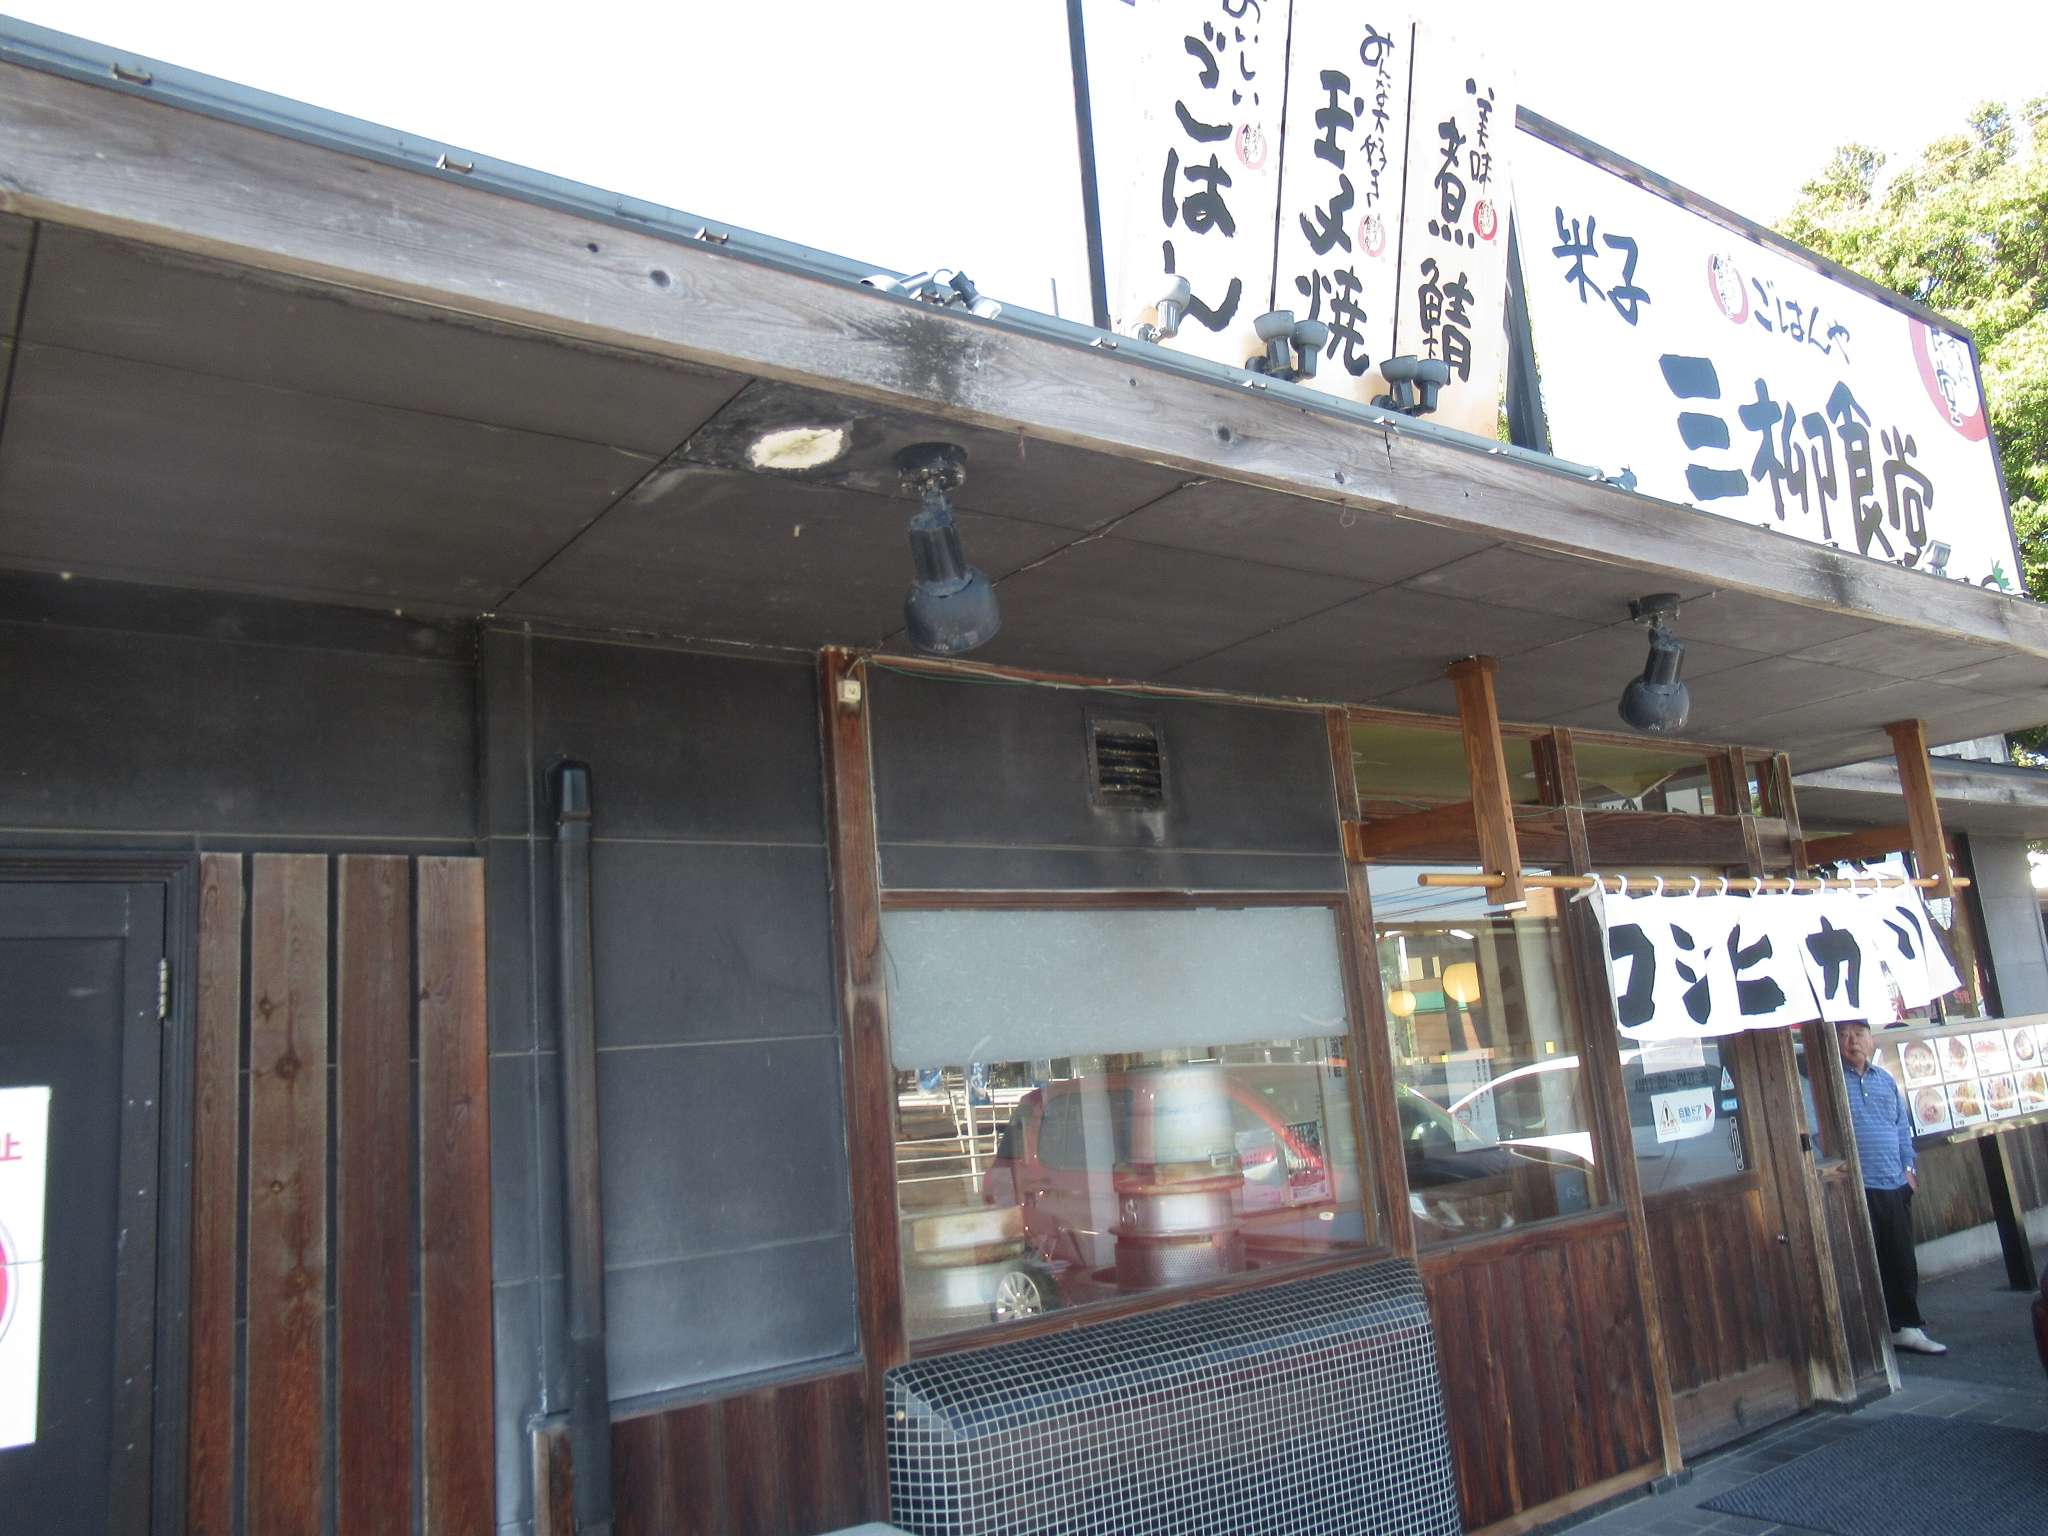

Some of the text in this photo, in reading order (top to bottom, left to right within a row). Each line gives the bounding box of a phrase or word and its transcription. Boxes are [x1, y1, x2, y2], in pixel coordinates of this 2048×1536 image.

[1162, 20, 1243, 332] ごはん
[1465, 77, 1495, 195] 美味
[1295, 69, 1370, 377] 玉子焼
[1417, 116, 1475, 385] 煮鯖
[1551, 205, 1652, 327] 米子
[1751, 276, 1851, 366] ごはんや
[1658, 353, 1935, 567] 三柳食堂
[1607, 904, 1927, 1028] コシヒカリ
